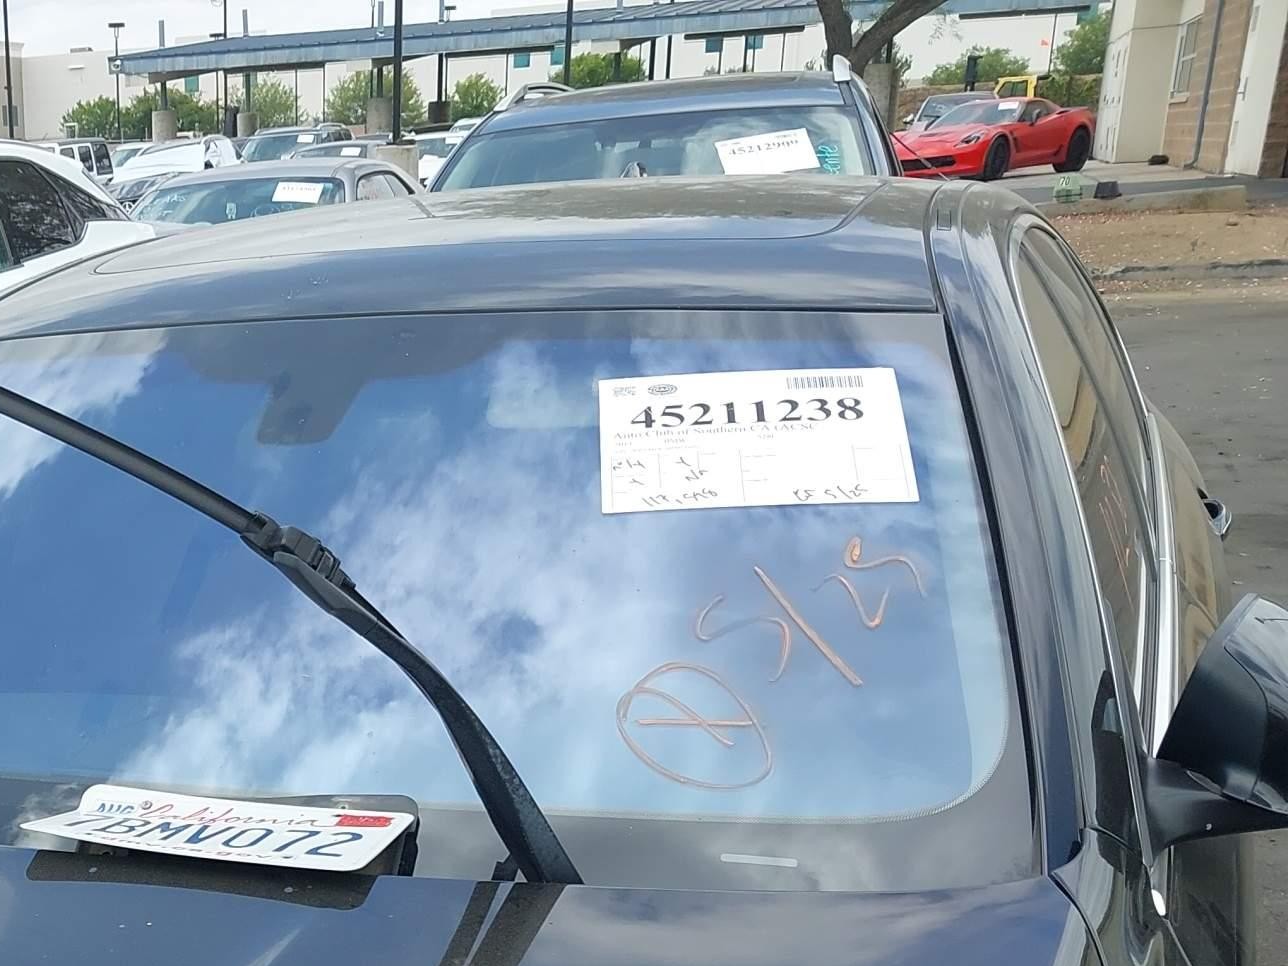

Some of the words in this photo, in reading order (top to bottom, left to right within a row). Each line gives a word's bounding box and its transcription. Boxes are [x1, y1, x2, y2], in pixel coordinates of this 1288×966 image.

[630, 397, 865, 430] 45211238
[138, 803, 324, 827] California
[63, 813, 364, 857] 7BMV072
